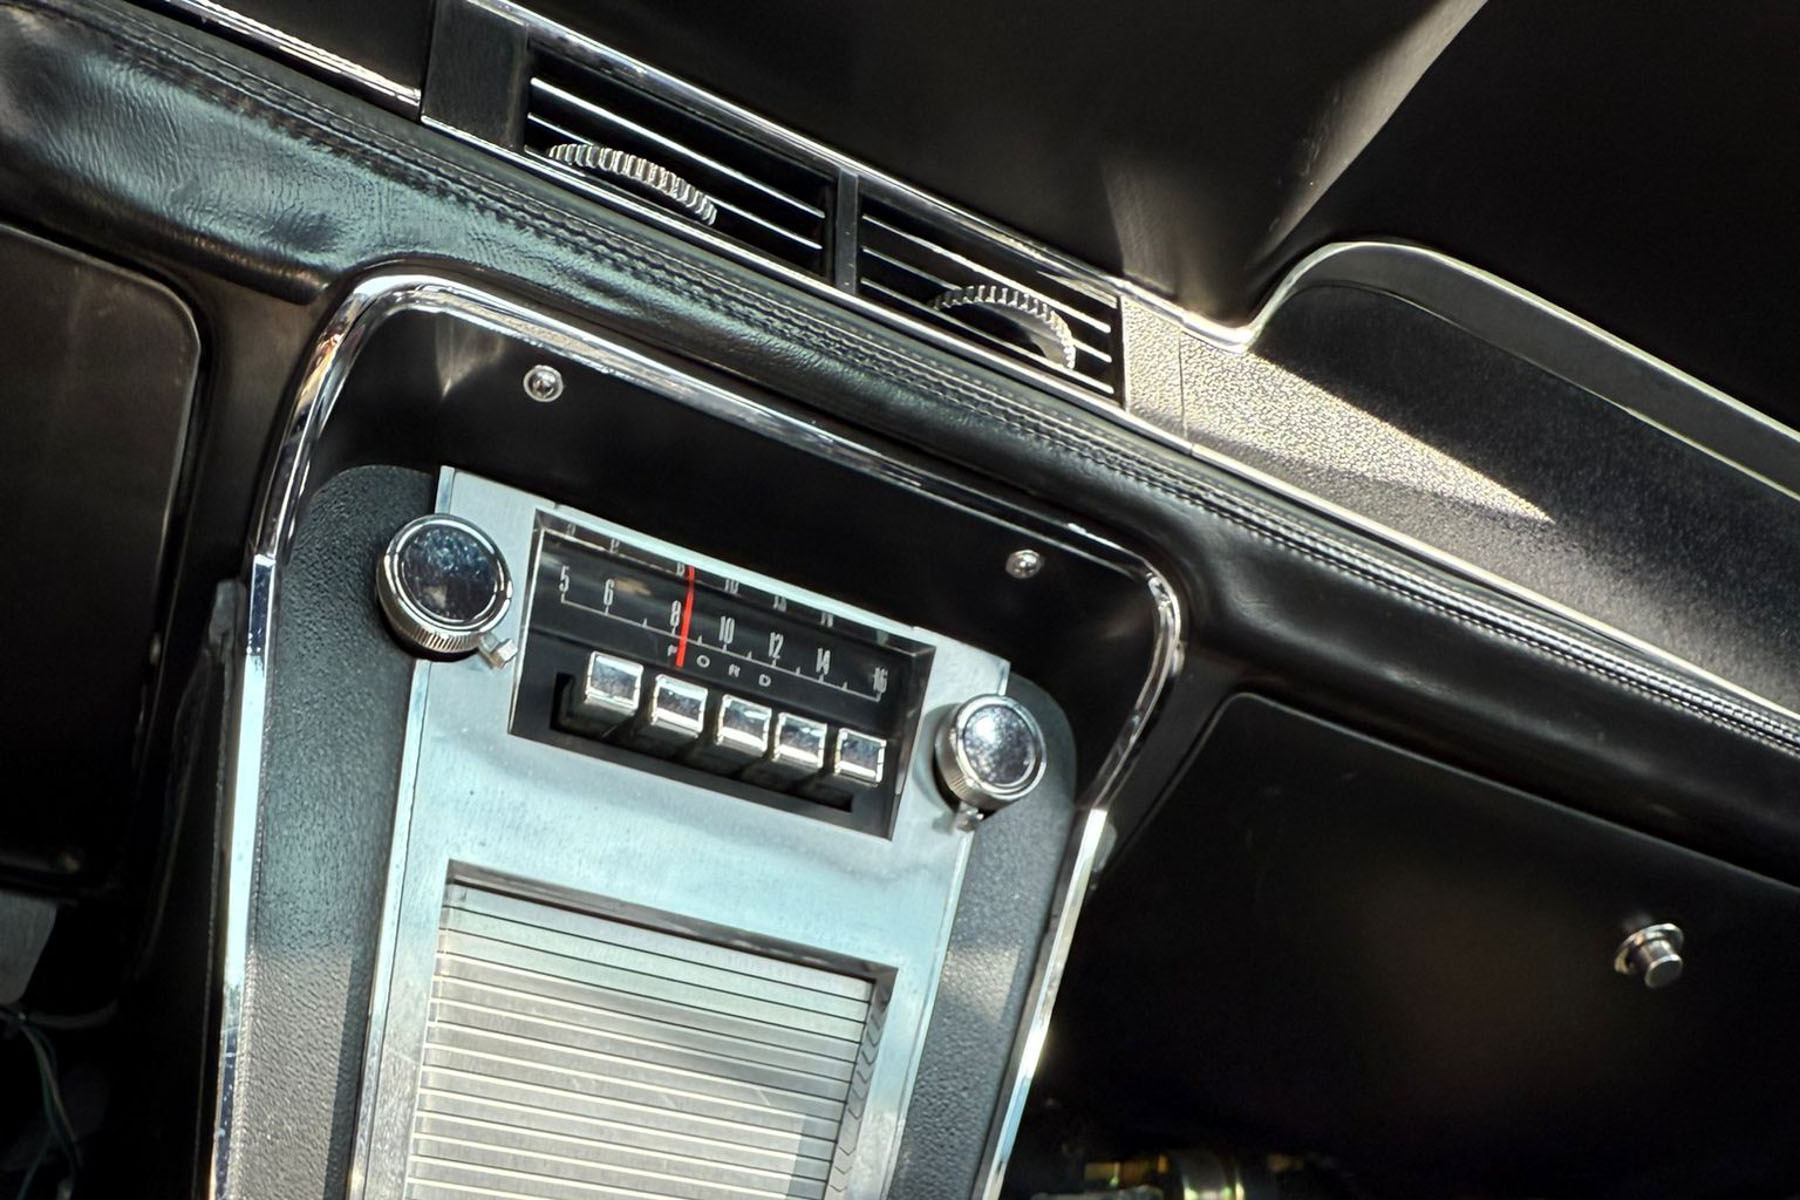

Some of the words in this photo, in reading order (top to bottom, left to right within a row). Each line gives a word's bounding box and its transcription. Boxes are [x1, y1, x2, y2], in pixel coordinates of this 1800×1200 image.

[558, 565, 570, 593] 5
[603, 578, 615, 606] 6
[669, 600, 682, 627] 8
[718, 615, 735, 644] 10
[768, 632, 784, 660] 12
[815, 647, 831, 676] 14
[873, 667, 888, 694] 16
